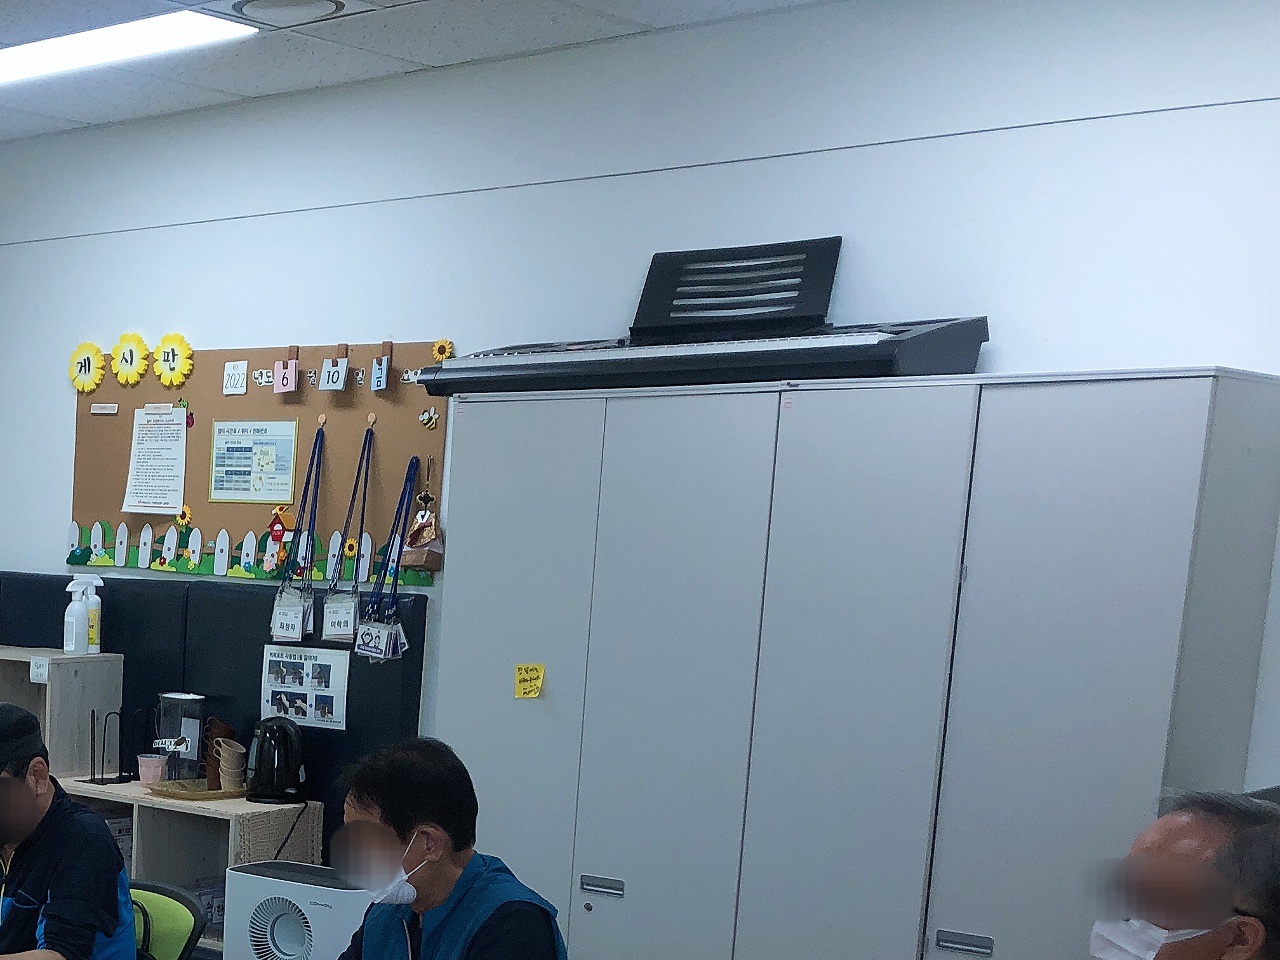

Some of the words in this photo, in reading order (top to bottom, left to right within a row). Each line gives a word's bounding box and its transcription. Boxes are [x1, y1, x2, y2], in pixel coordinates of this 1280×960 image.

[224, 372, 246, 389] 2022
[253, 369, 274, 385] 년도
[281, 371, 289, 388] 6
[307, 369, 318, 386] 월
[325, 370, 340, 386] 10
[355, 369, 365, 386] 일
